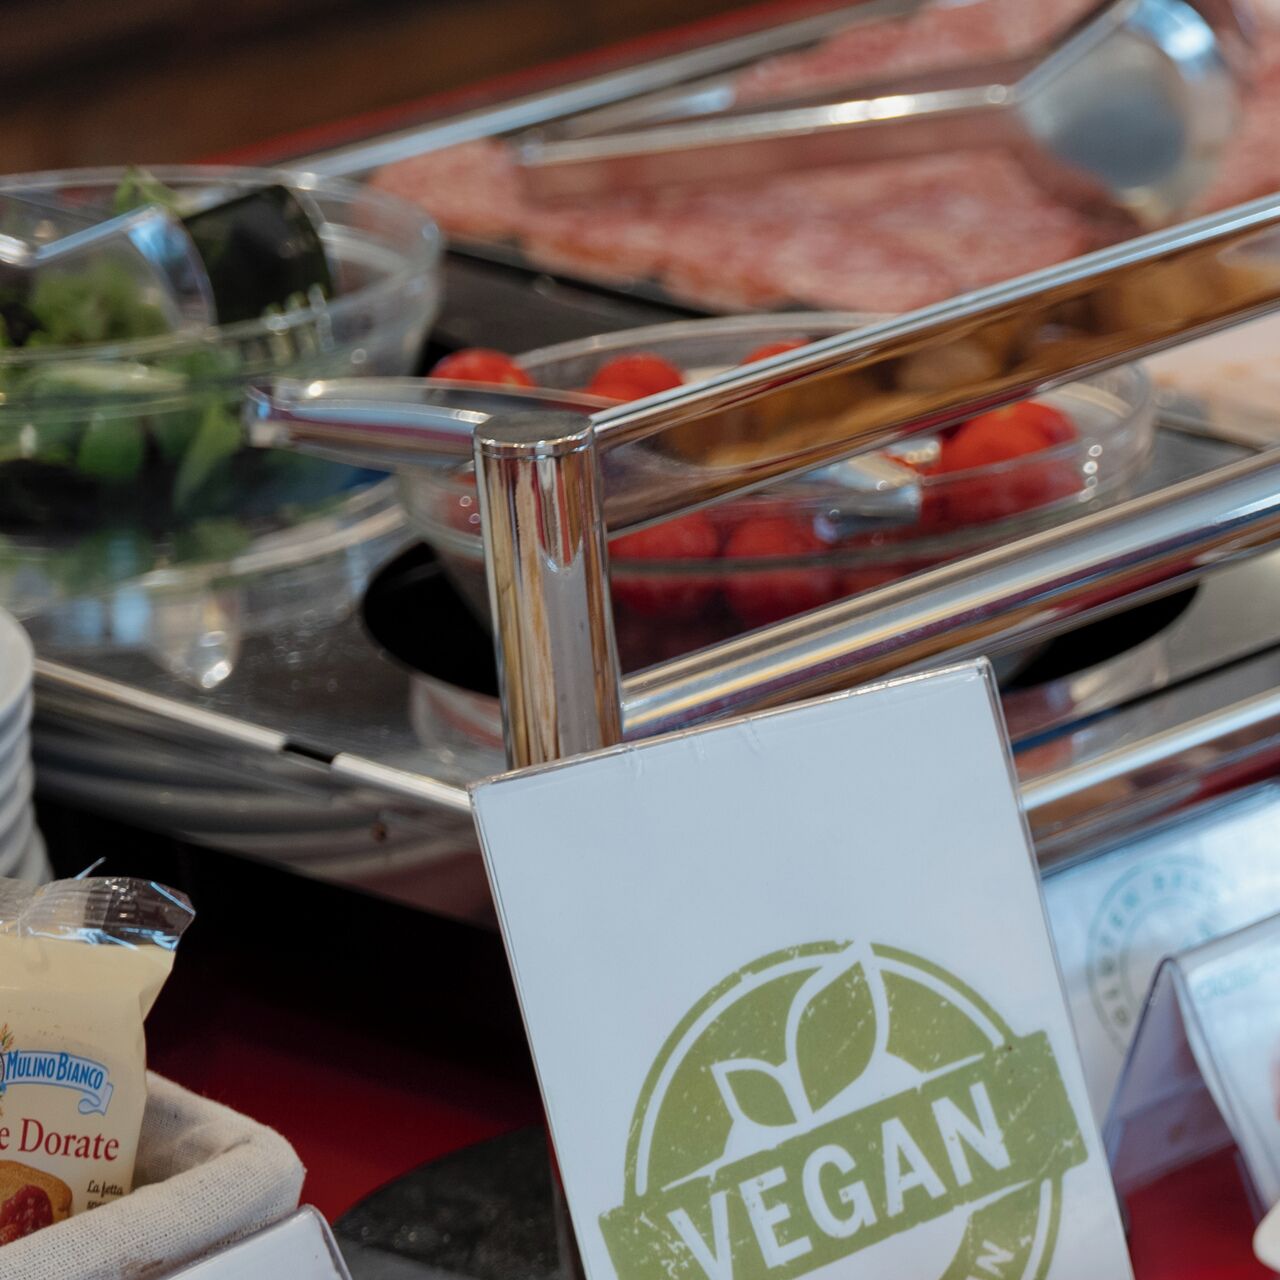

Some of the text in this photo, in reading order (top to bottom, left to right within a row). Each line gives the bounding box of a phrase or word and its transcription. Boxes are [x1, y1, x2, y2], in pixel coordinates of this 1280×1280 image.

[6, 1049, 104, 1090] MULINO BIANCO
[18, 1118, 119, 1161] Dorate
